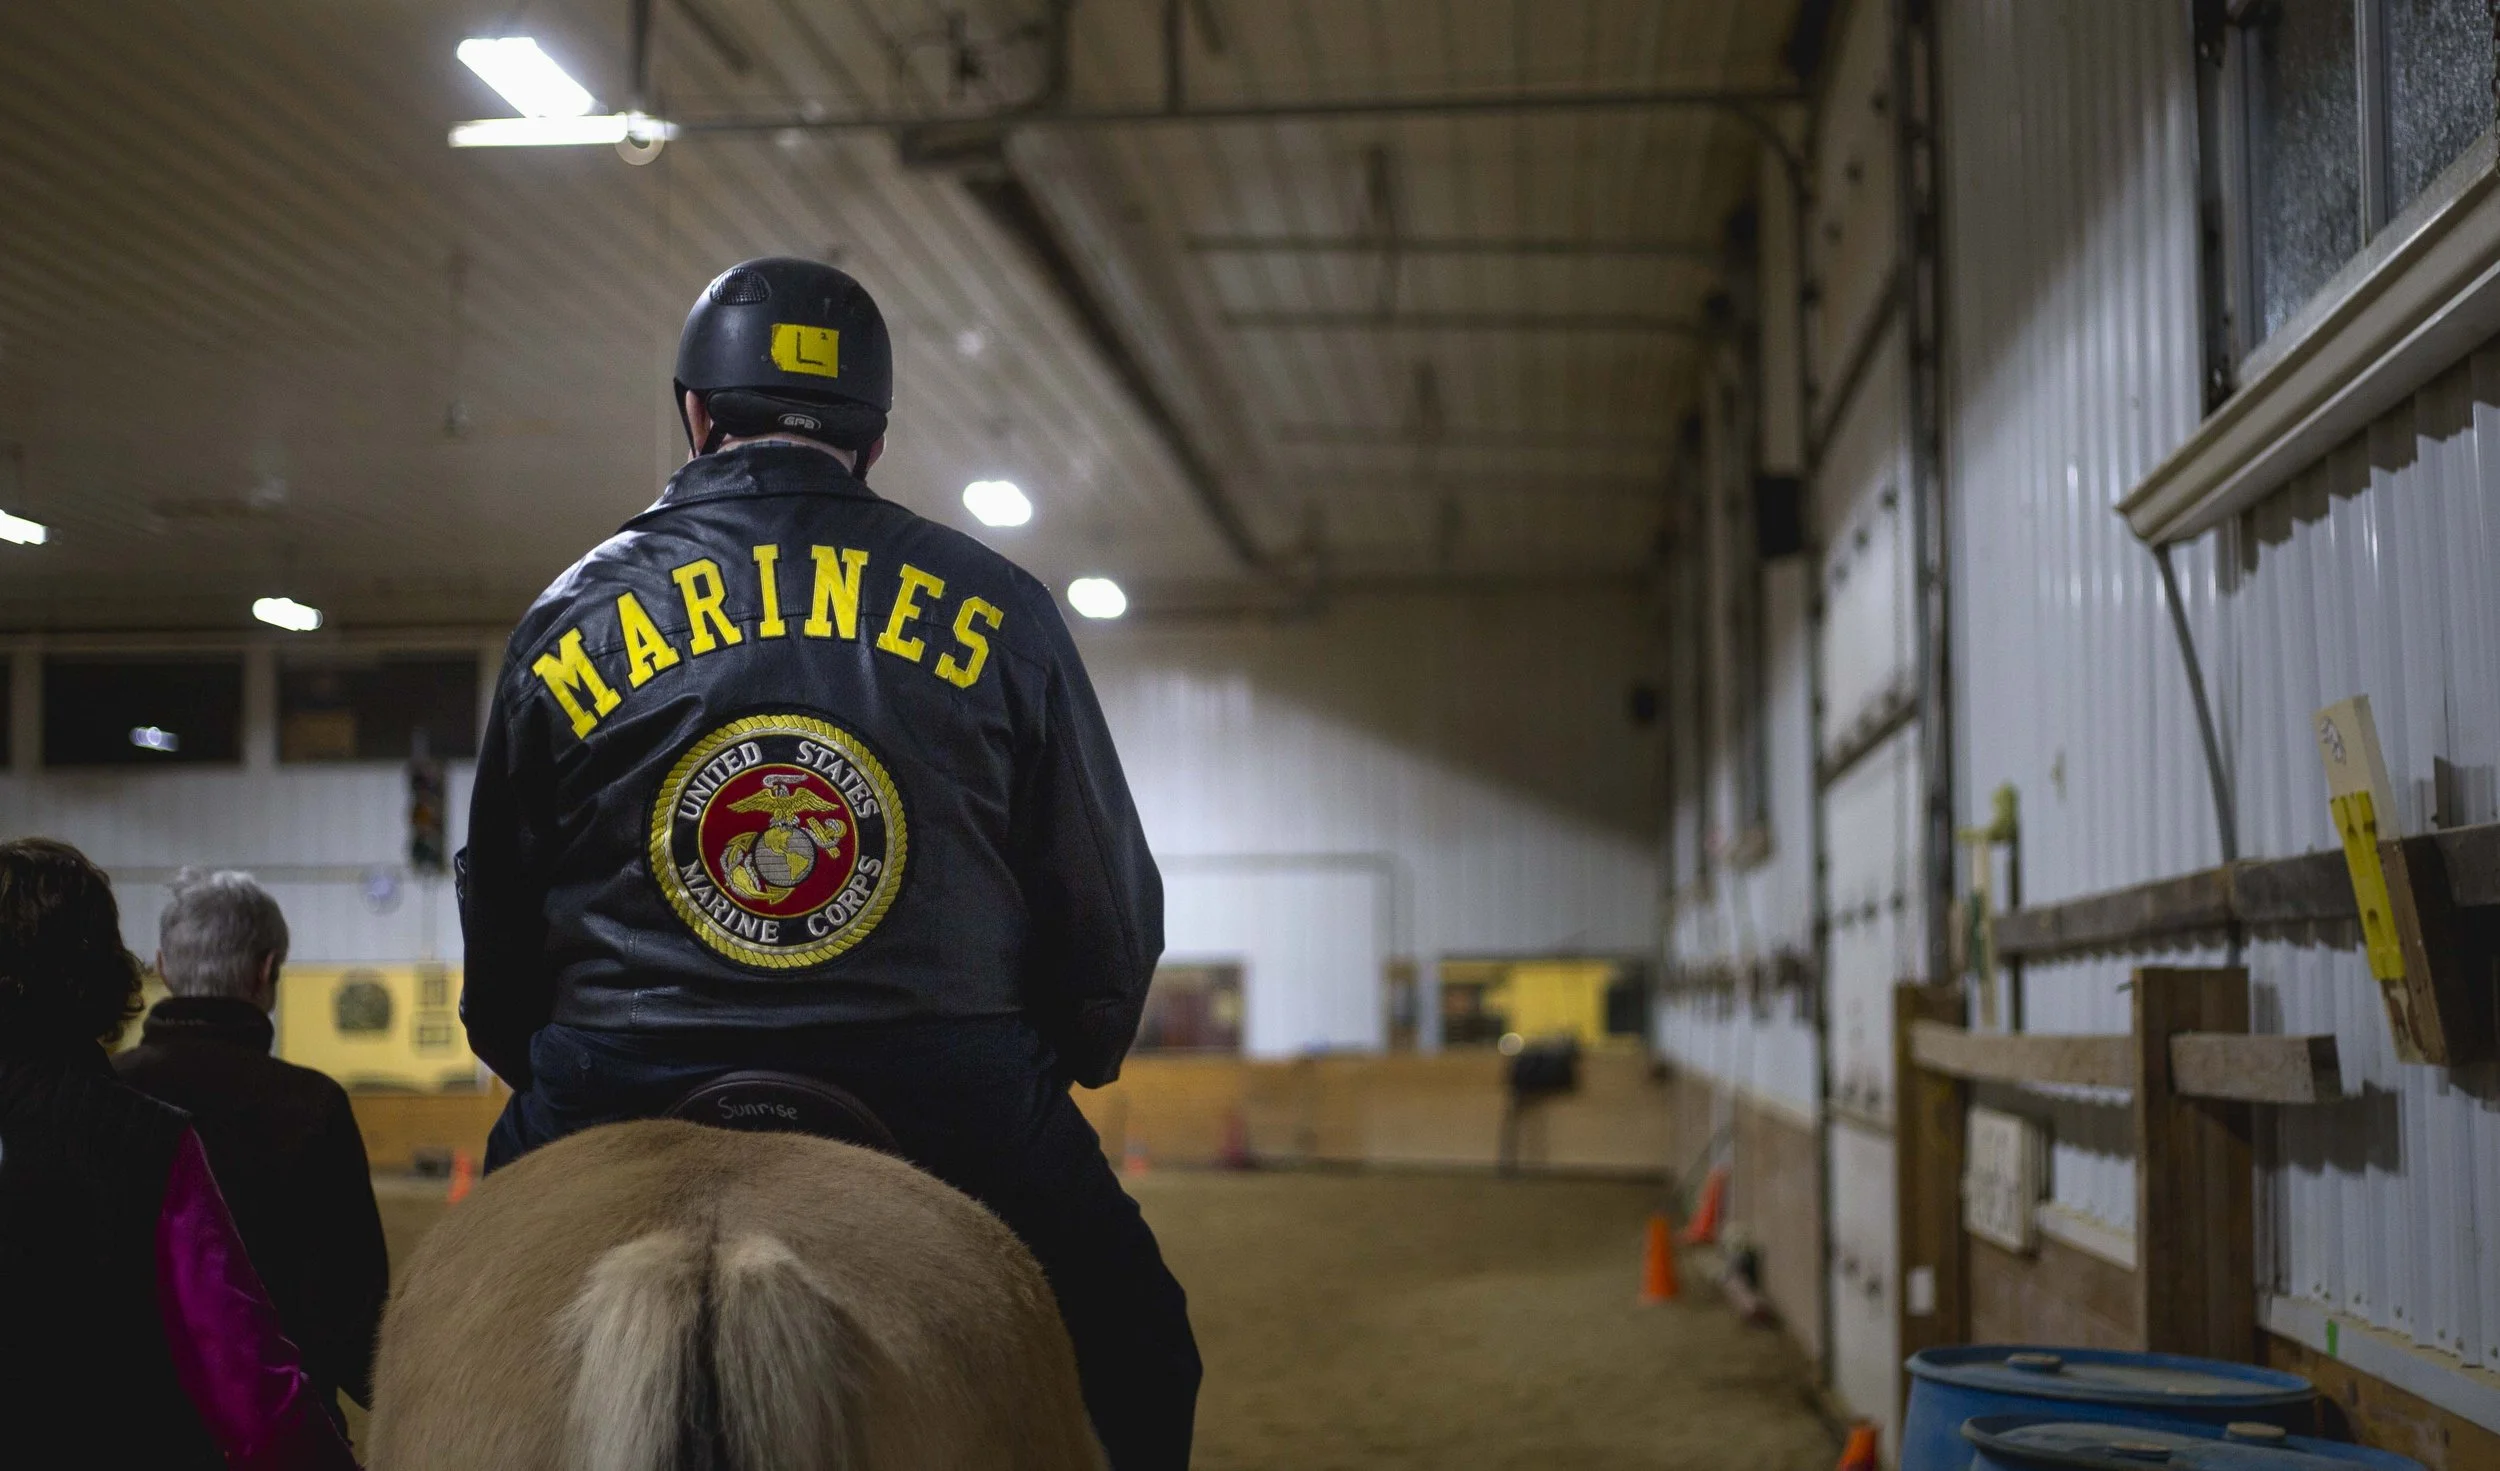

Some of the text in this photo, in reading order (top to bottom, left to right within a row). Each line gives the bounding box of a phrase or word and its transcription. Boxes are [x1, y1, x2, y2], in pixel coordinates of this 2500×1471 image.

[532, 543, 1004, 740] MARINES
[679, 740, 880, 821] UNITED STATES
[679, 855, 882, 943] MARINE CORPS
[717, 1096, 799, 1121] Sunrise
